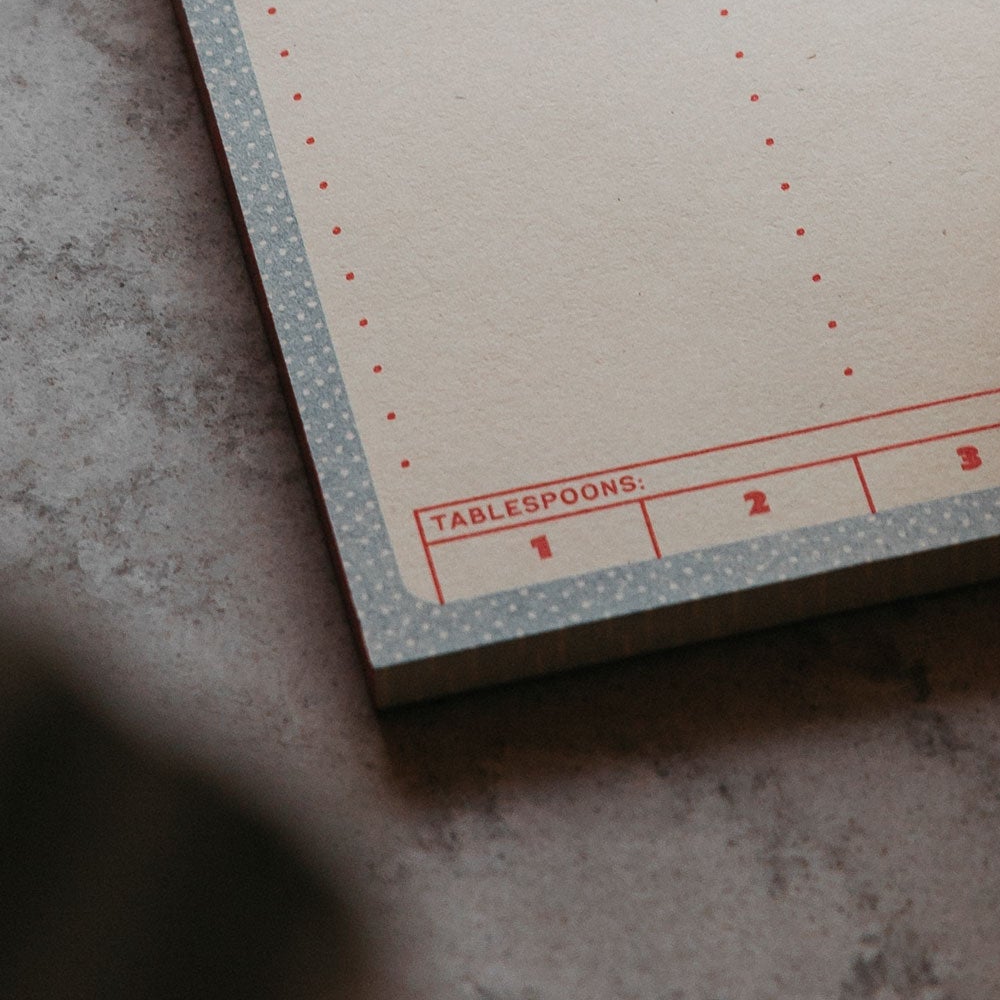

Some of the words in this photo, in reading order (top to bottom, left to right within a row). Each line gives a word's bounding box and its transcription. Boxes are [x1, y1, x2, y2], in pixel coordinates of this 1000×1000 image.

[955, 443, 984, 472] 3
[430, 475, 646, 532] TABLESPOONS:
[742, 489, 772, 518] 2
[529, 533, 553, 561] 1
